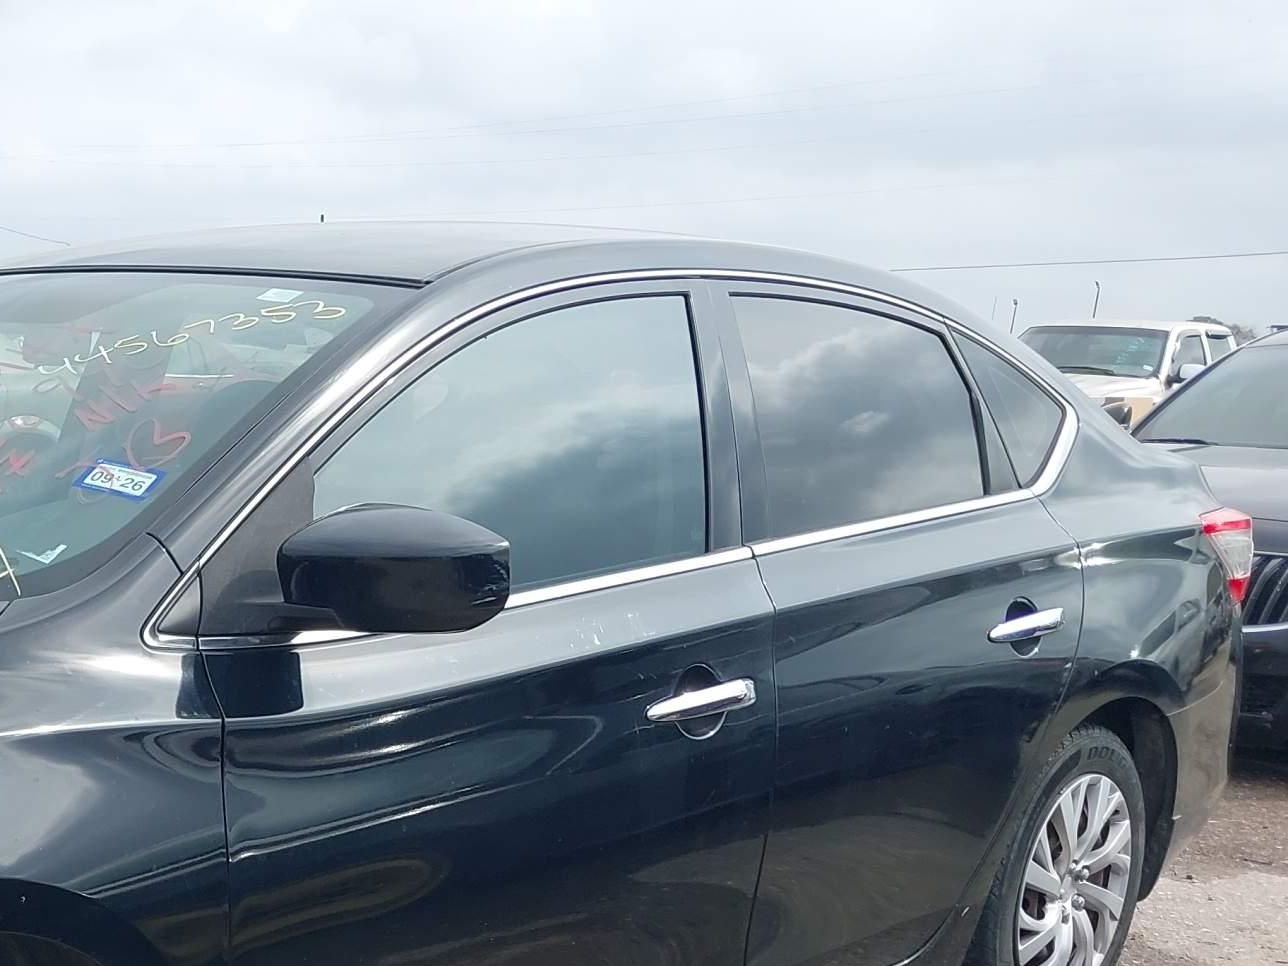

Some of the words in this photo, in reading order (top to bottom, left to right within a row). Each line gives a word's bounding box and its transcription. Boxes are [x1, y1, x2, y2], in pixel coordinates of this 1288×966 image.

[38, 300, 346, 375] 44567353
[90, 471, 114, 484] 09
[119, 477, 146, 491] 26
